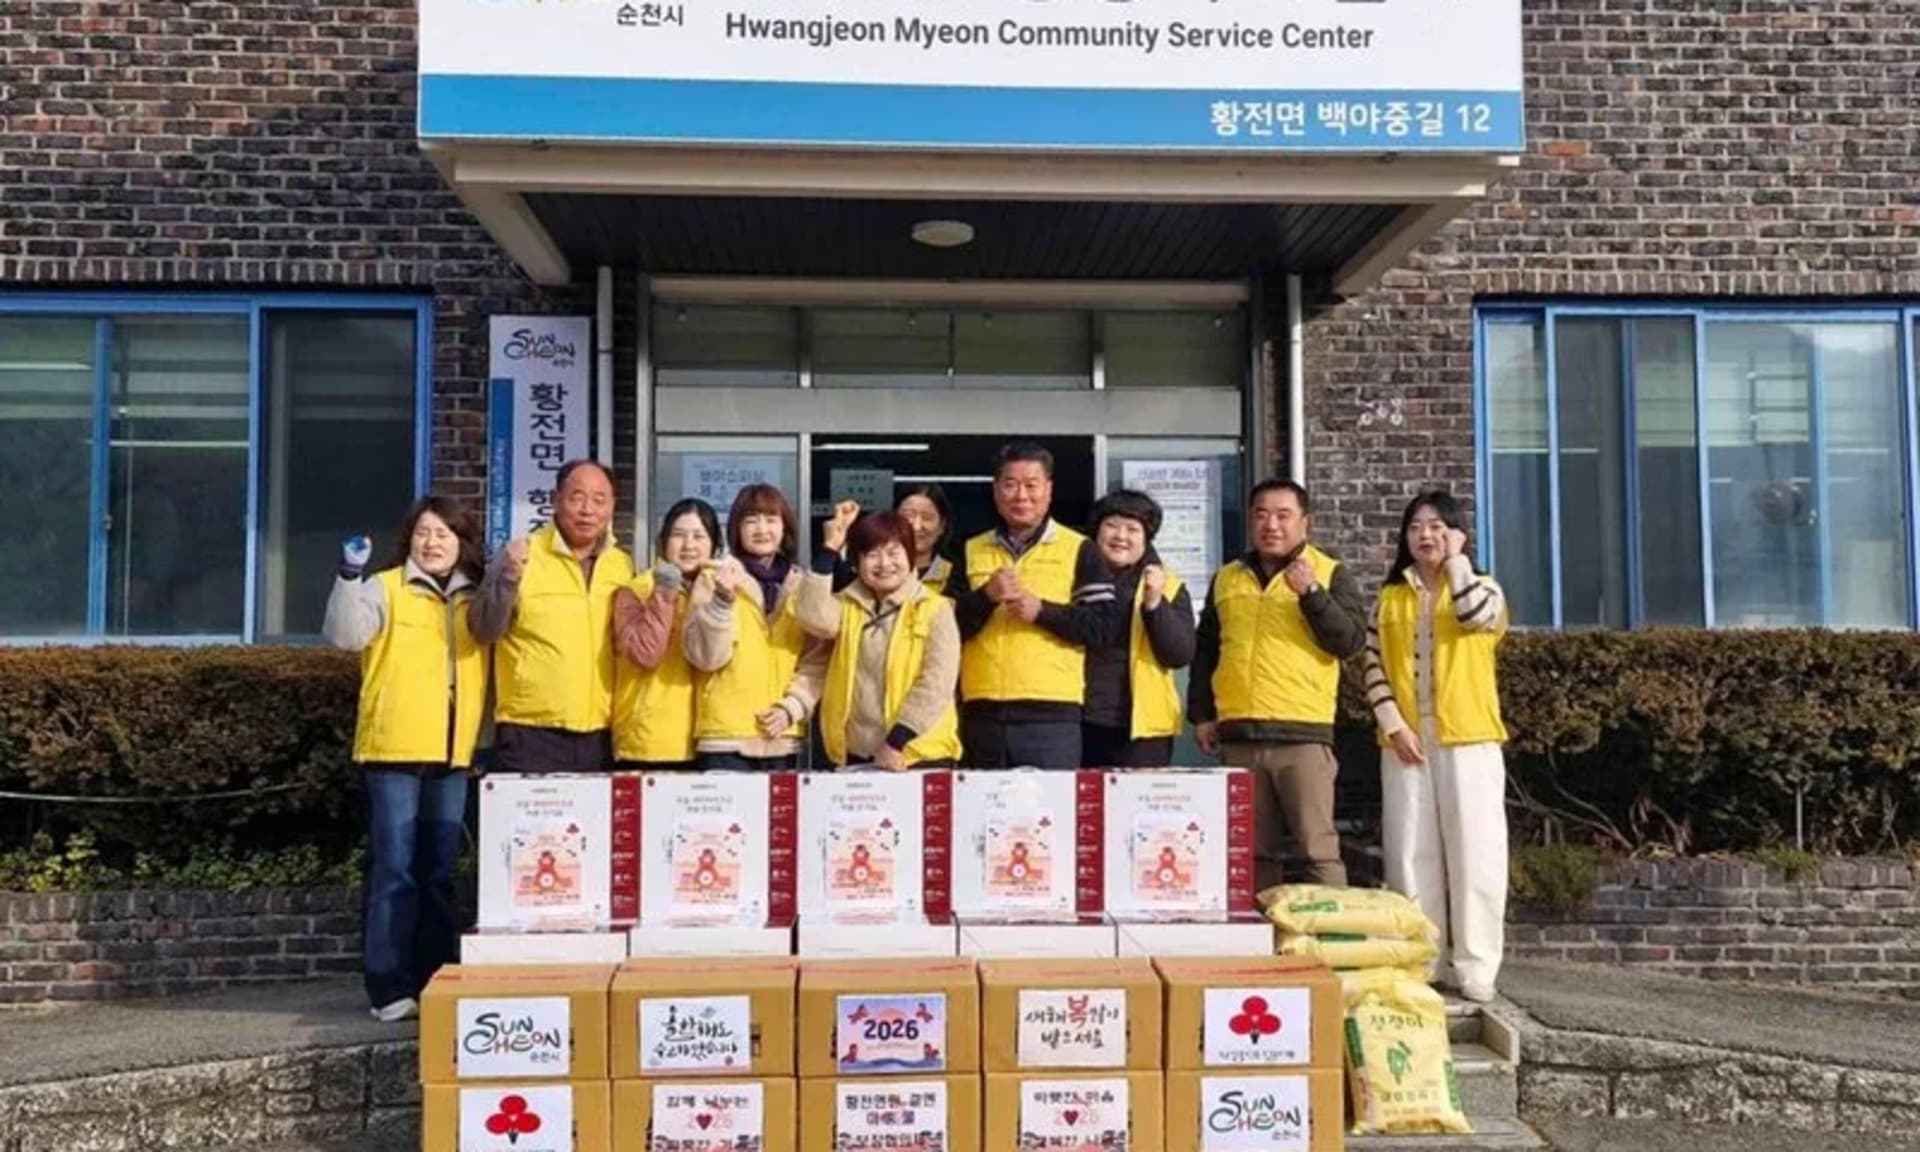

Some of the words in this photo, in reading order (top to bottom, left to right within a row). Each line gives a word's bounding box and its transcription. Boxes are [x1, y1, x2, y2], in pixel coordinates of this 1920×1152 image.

[616, 3, 684, 26] 순천시
[726, 13, 885, 47] Hwangjeon
[894, 18, 989, 50] Myeon
[998, 20, 1158, 52] Community
[1168, 23, 1273, 48] Service
[1281, 23, 1374, 49] Center
[1210, 101, 1305, 137] 황전면
[1317, 101, 1444, 137] 백야중길
[1457, 104, 1491, 132] 12
[528, 382, 568, 471] 황전면
[463, 1028, 561, 1054] CHEON
[475, 1012, 534, 1046] SUN
[863, 1019, 919, 1040] 2026
[1208, 1106, 1301, 1132] CHEON
[1219, 1091, 1275, 1123] SUN
